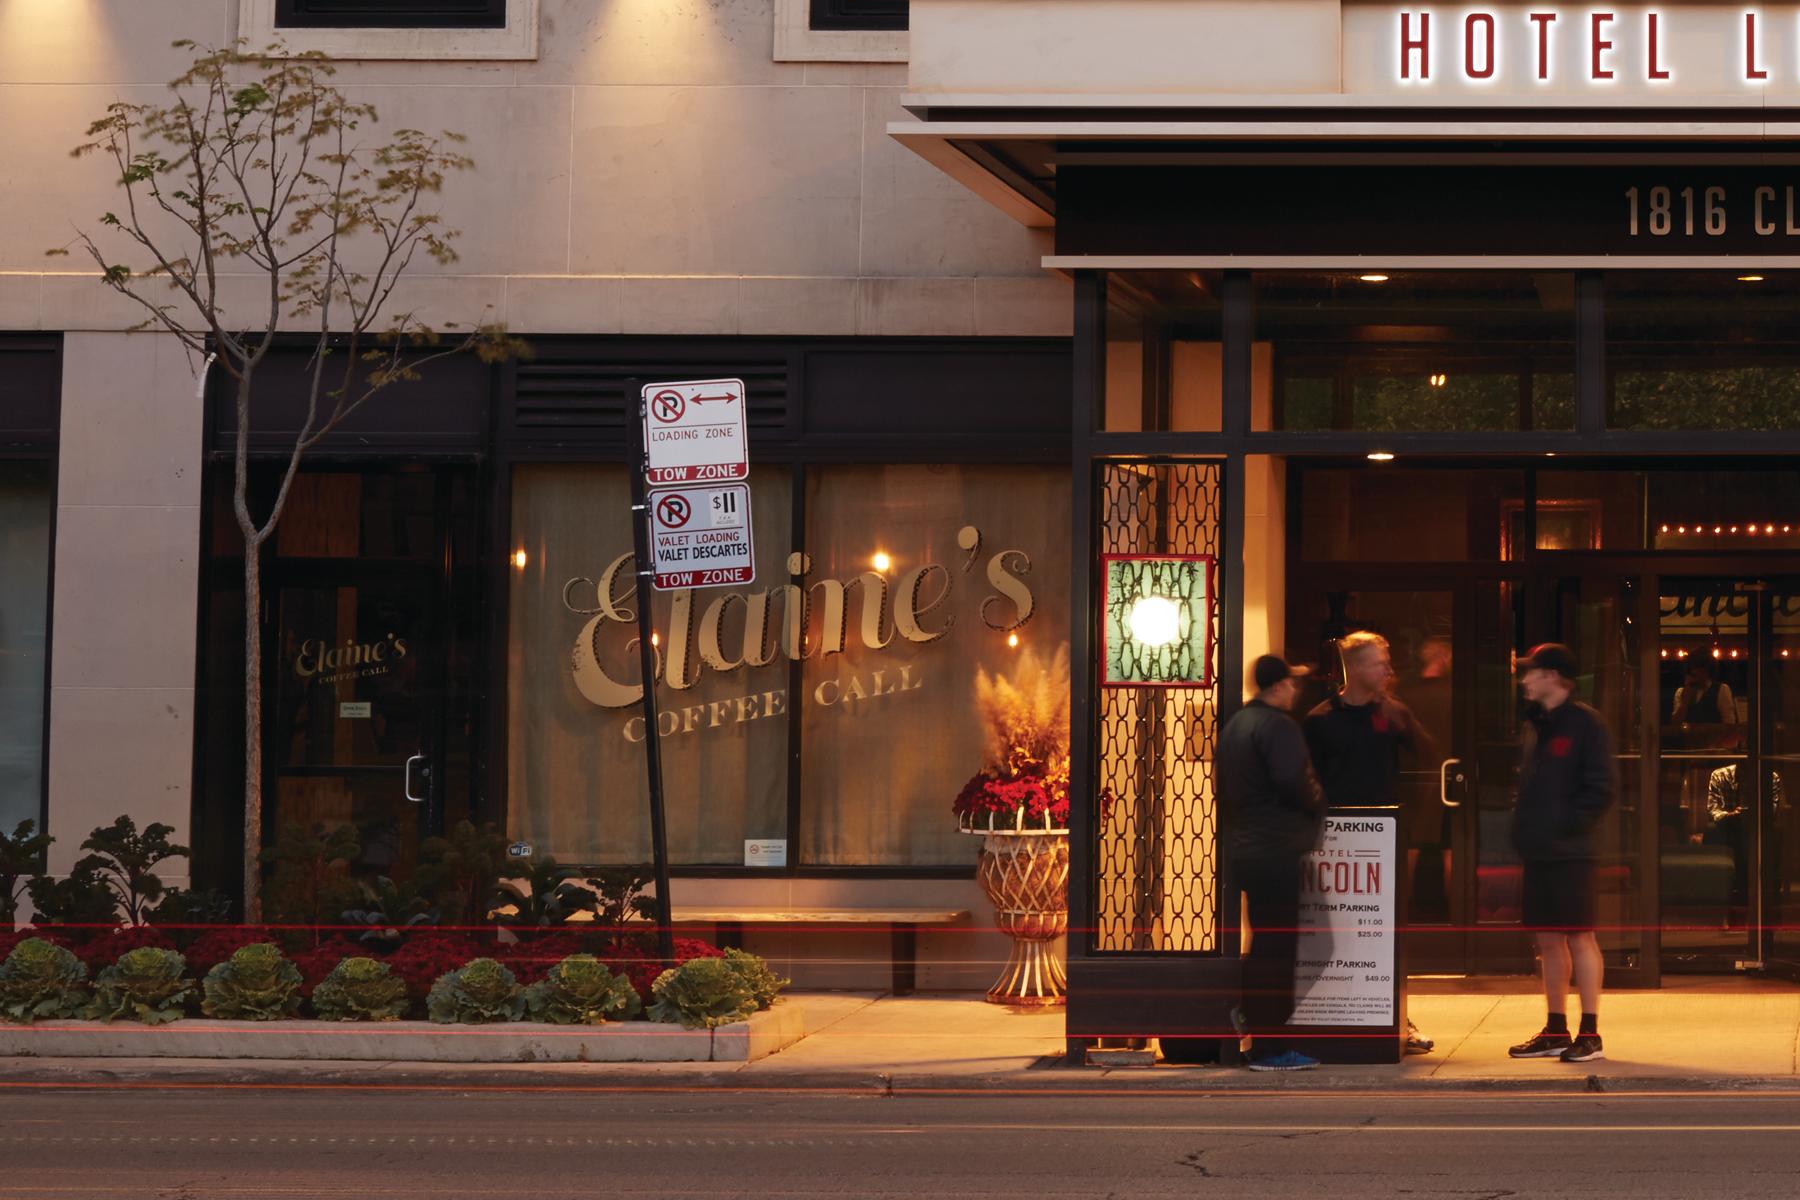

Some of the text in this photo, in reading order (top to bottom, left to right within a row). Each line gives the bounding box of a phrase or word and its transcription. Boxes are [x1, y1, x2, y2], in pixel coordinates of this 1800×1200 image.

[1400, 13, 1670, 80] HOTEL
[1625, 186, 1727, 236] 1816
[652, 427, 734, 442] LOADING ZONE
[653, 463, 739, 481] TOW ZONE
[712, 492, 736, 513] $11
[658, 531, 740, 547] VALET LOADING
[658, 542, 748, 561] VALET DESCARTES
[660, 568, 745, 587] TOW ZONE
[563, 526, 1035, 709] Elaine's
[296, 632, 408, 677] Elaine's
[622, 664, 922, 743] COFFEE CALL
[1301, 861, 1381, 894] NCOLN
